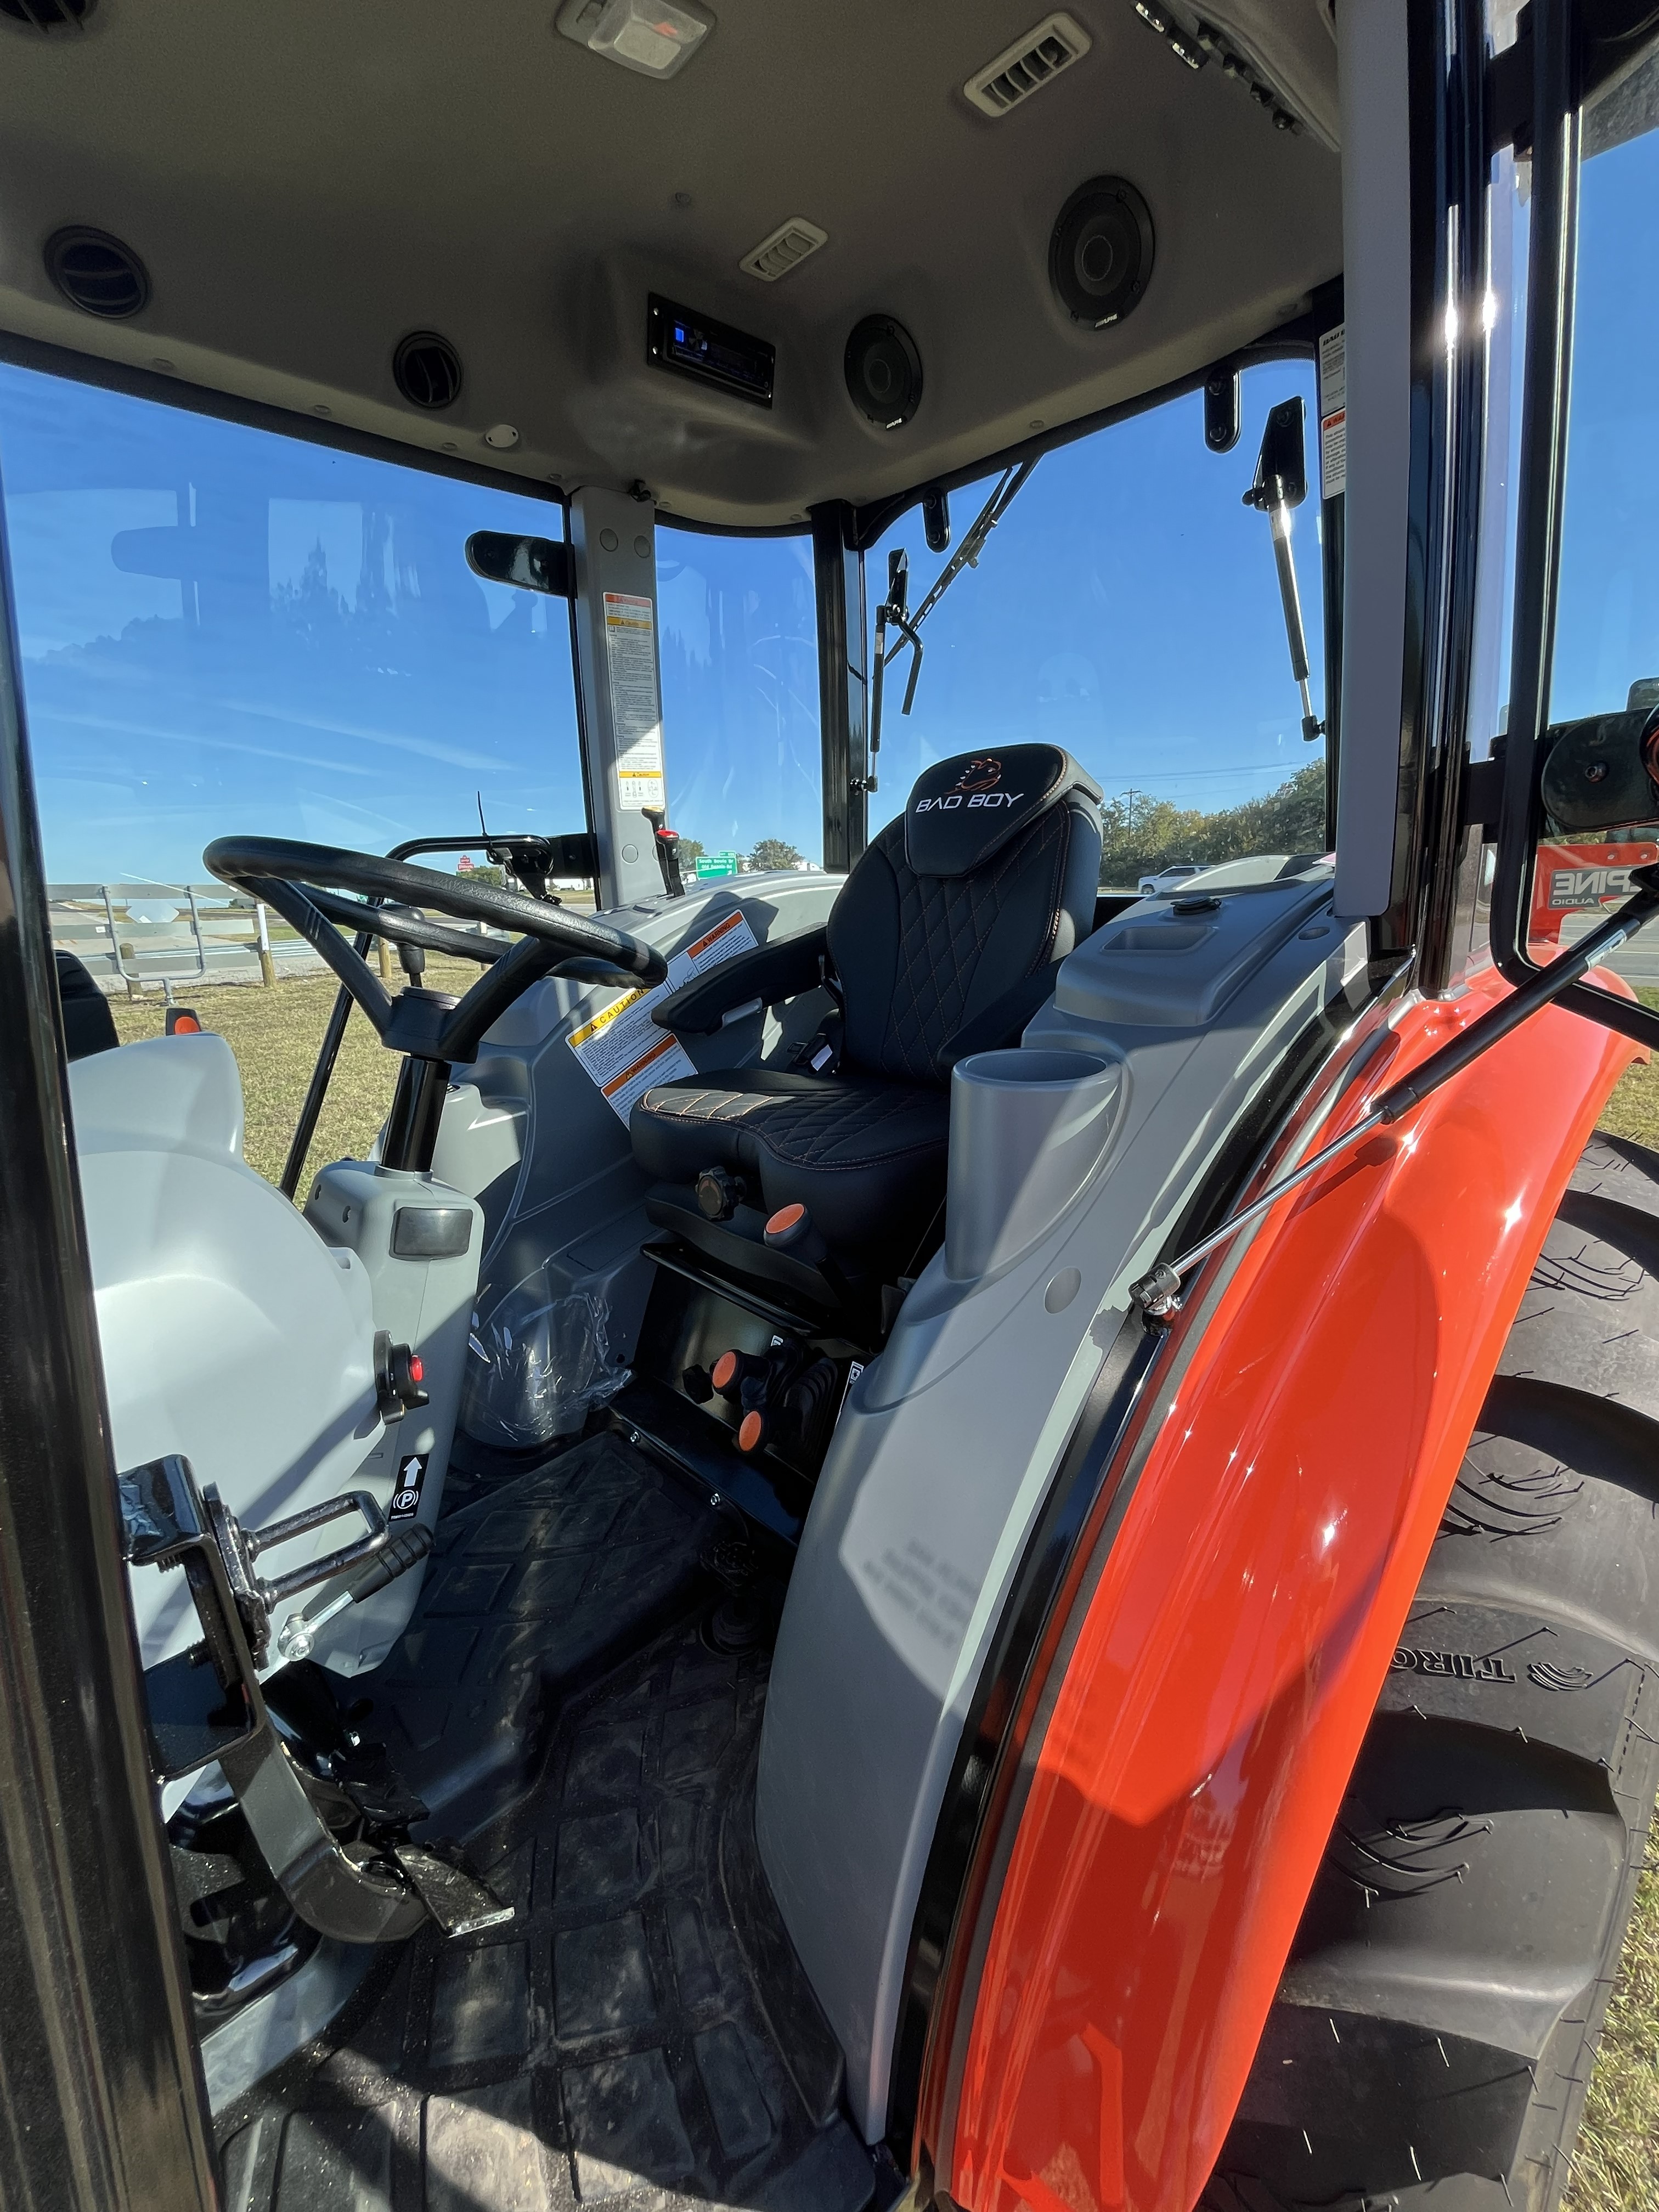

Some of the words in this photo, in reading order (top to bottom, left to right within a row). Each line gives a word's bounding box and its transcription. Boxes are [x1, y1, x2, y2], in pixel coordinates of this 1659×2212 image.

[915, 794, 963, 814] BAD
[967, 793, 1024, 809] BOY
[707, 922, 730, 944] WARNING
[600, 988, 645, 1024] CAUTION
[631, 1052, 656, 1074] WARNING
